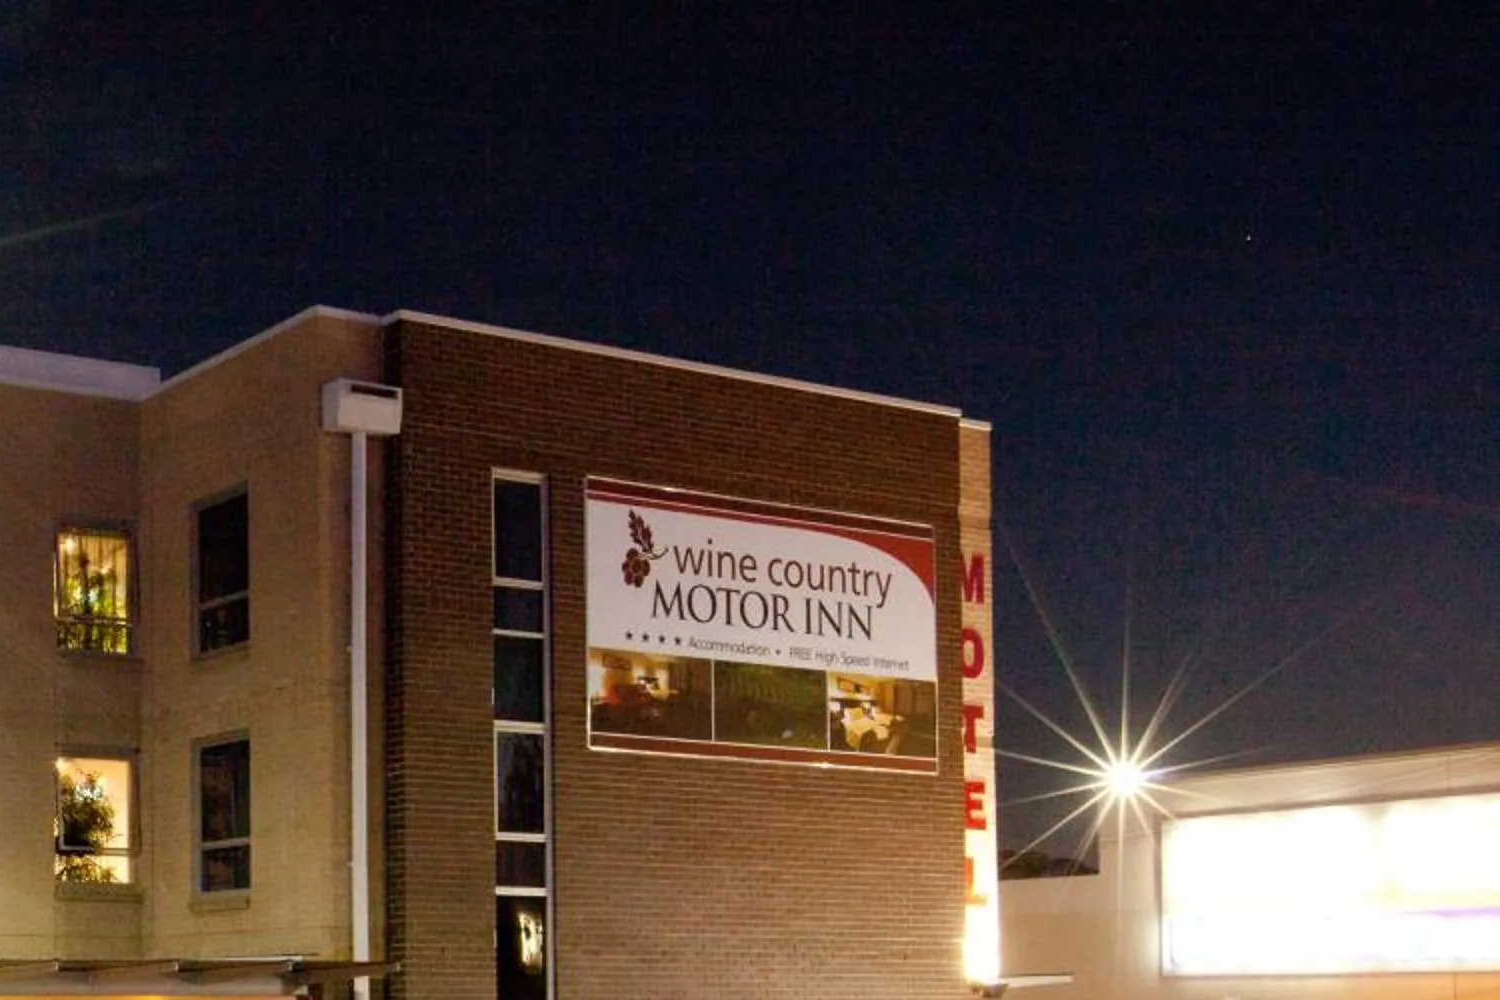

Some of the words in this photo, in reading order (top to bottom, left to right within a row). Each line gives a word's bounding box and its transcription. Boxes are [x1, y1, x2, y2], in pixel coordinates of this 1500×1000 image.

[673, 538, 757, 583] wine
[768, 556, 892, 608] country
[651, 580, 795, 634] MOTOR
[803, 599, 874, 640] INN
[789, 647, 813, 660] FREE
